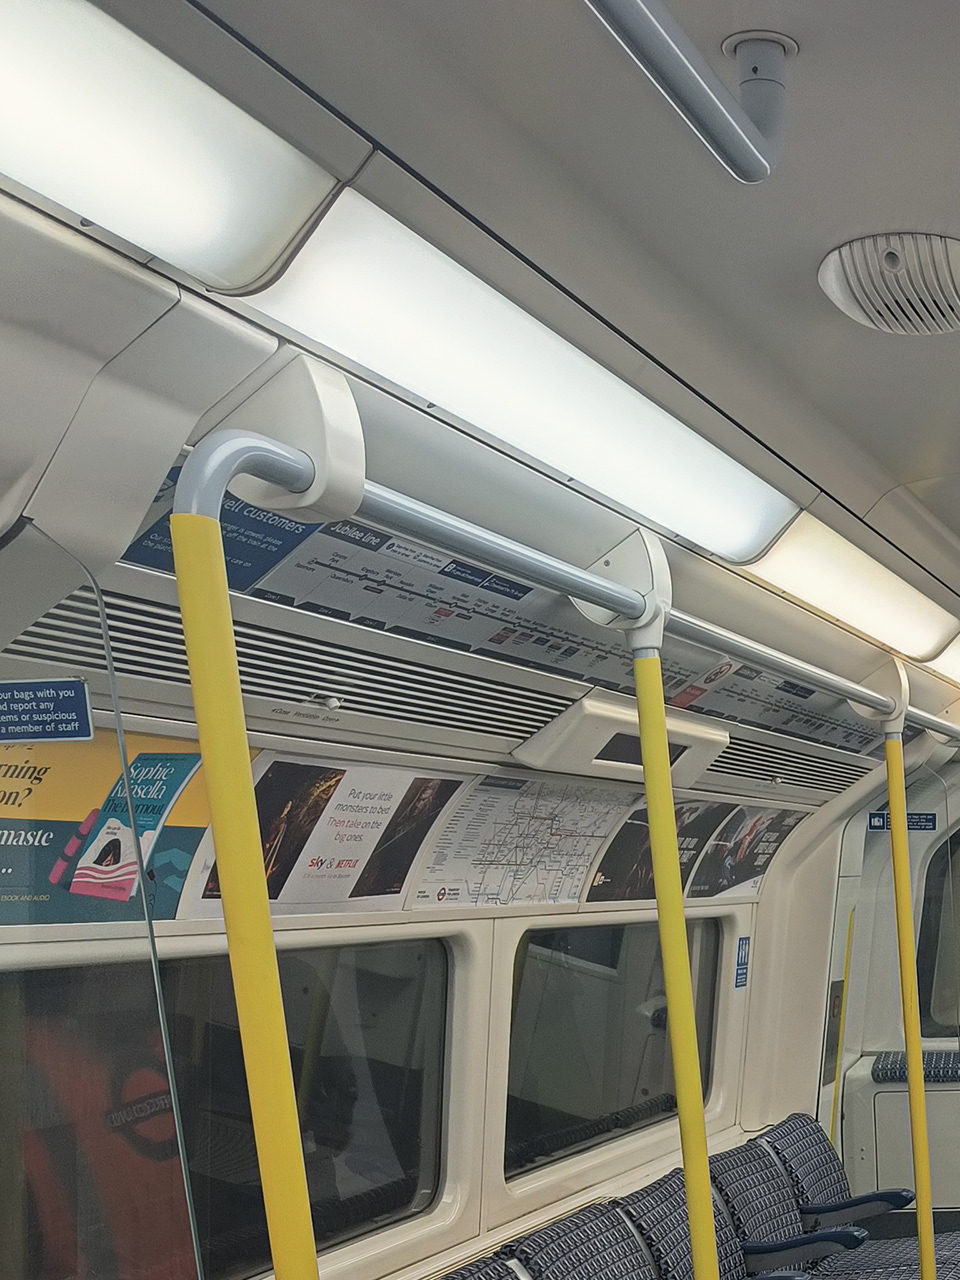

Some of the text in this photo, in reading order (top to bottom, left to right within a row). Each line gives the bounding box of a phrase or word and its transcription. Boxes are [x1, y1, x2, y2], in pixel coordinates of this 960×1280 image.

[244, 507, 306, 534] customers
[331, 522, 380, 546] Jubilee line
[14, 690, 34, 700] bags
[36, 688, 56, 698] with
[58, 689, 74, 699] you
[10, 702, 38, 712] report
[40, 702, 54, 711] any
[32, 711, 77, 722] suspicious
[8, 724, 42, 733] member
[46, 722, 56, 732] of
[58, 722, 80, 732] staff
[123, 762, 174, 784] Sophie
[348, 788, 394, 802] Put your little
[334, 803, 369, 814] monsters
[368, 806, 377, 814] to
[327, 817, 382, 829] Then take on the
[334, 831, 347, 844] big
[309, 856, 327, 870] sky
